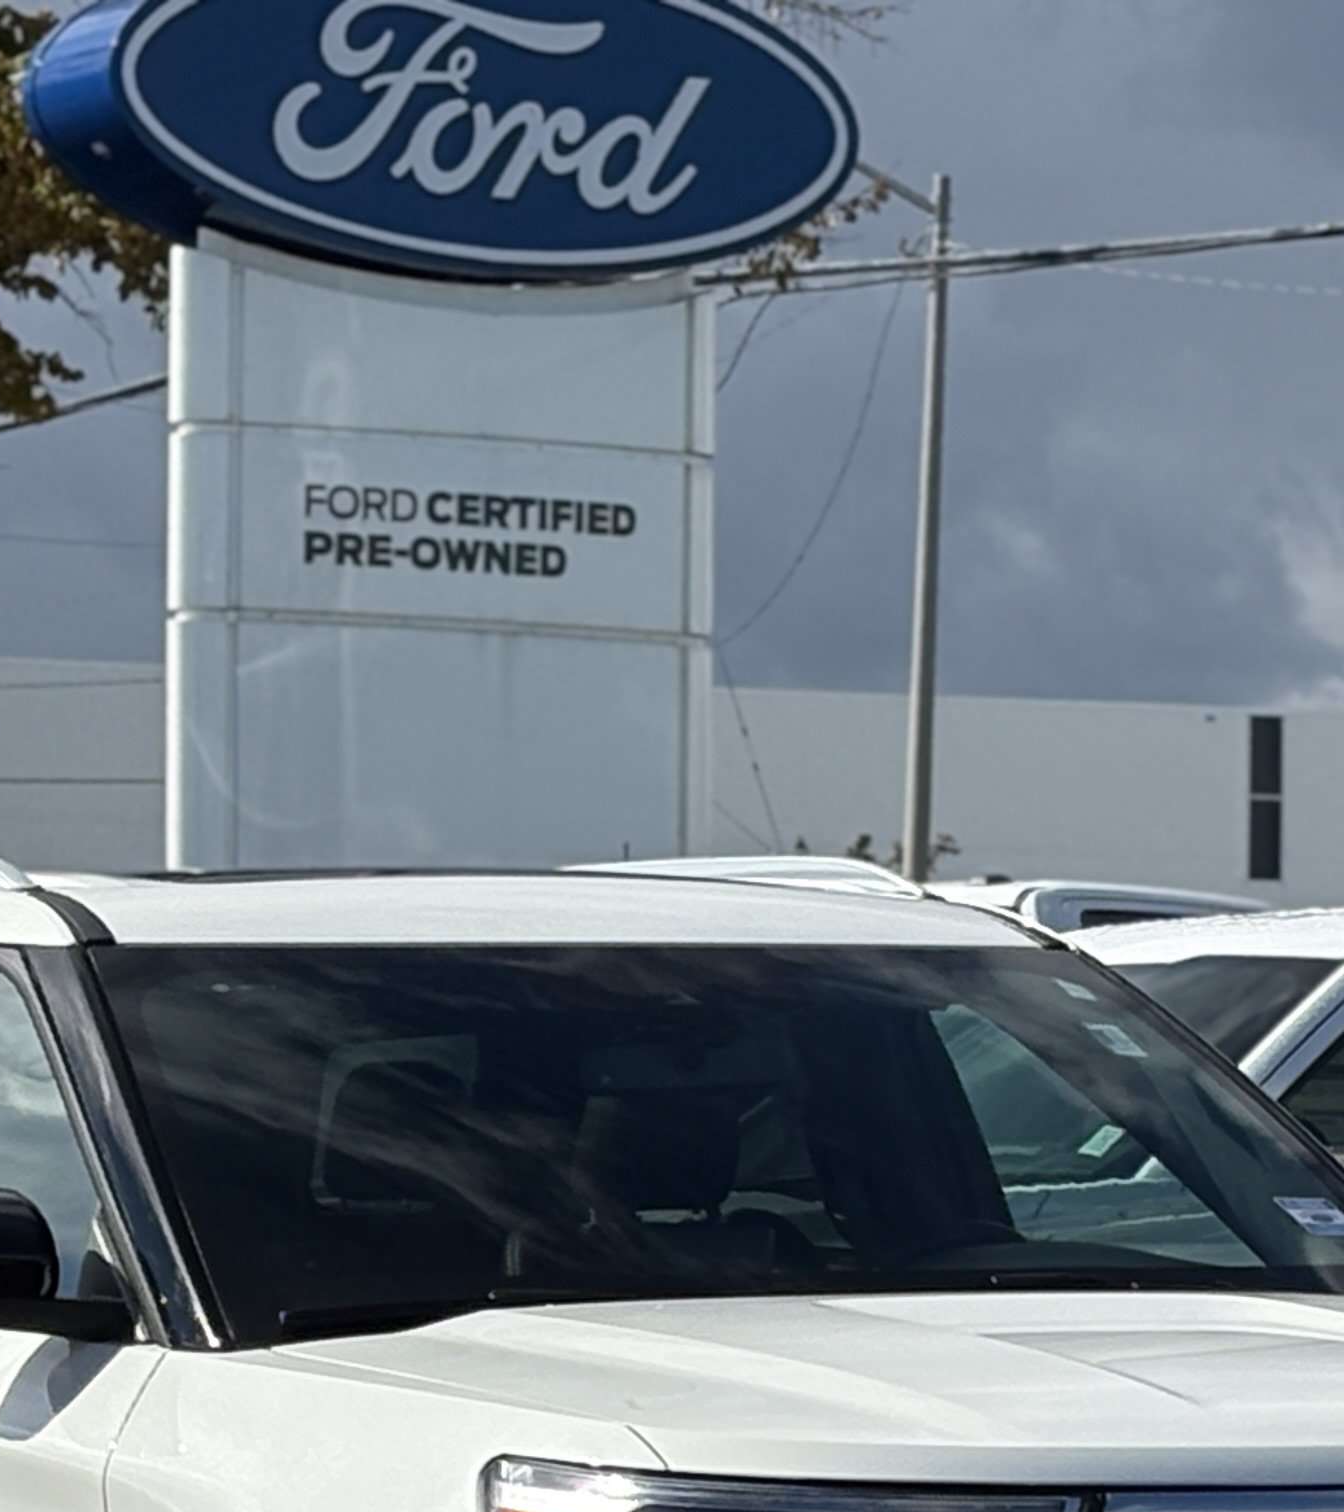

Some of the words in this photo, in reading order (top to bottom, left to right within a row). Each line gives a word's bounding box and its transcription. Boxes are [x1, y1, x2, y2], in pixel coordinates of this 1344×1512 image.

[273, 0, 711, 214] Ford
[305, 484, 418, 523] FORD
[425, 492, 637, 537] CERTIFIED
[304, 530, 567, 578] PRE-OWNED
